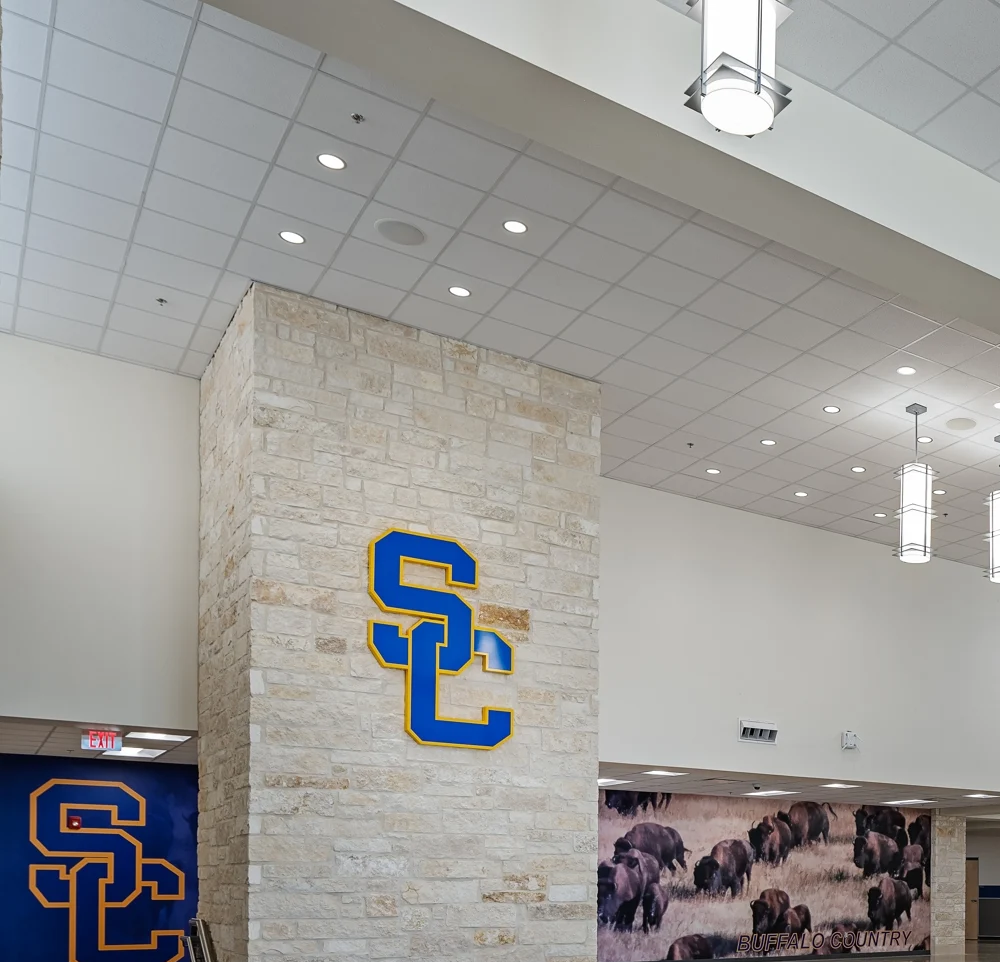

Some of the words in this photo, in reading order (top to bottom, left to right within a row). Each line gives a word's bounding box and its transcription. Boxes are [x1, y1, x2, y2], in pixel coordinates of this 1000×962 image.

[88, 730, 117, 749] EXIT
[737, 932, 825, 952] BUFFALO
[831, 931, 912, 948] COUNTRY
